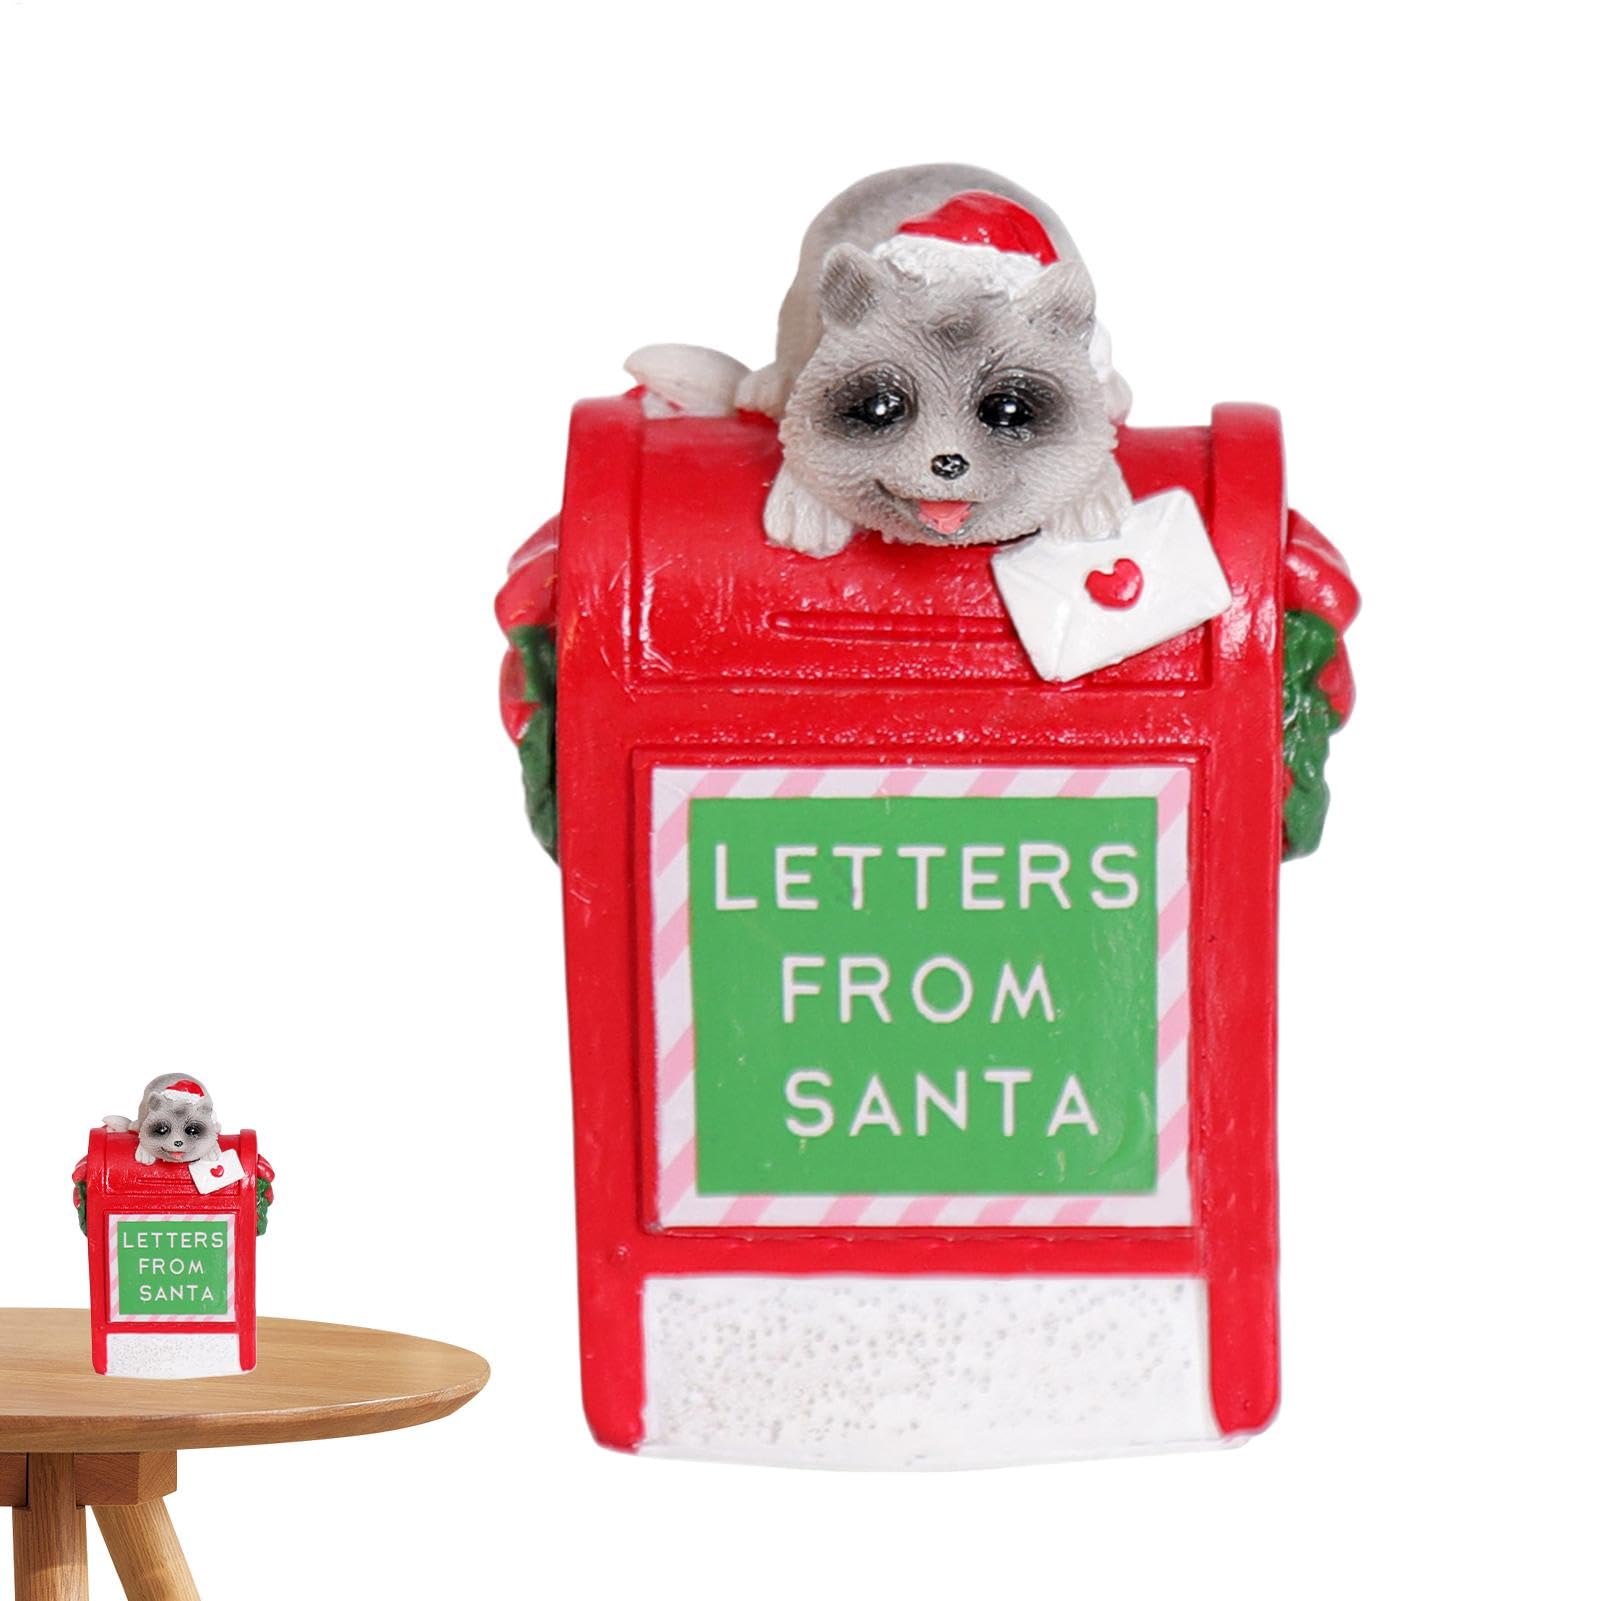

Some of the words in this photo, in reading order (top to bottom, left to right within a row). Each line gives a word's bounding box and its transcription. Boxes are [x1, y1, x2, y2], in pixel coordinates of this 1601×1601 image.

[714, 841, 1141, 912] LETTERS
[781, 953, 1057, 1024] FROM
[784, 1068, 1101, 1138] SANTA
[122, 1231, 224, 1249] LETTERS
[138, 1257, 205, 1276] FROM
[139, 1284, 215, 1302] SANTA
